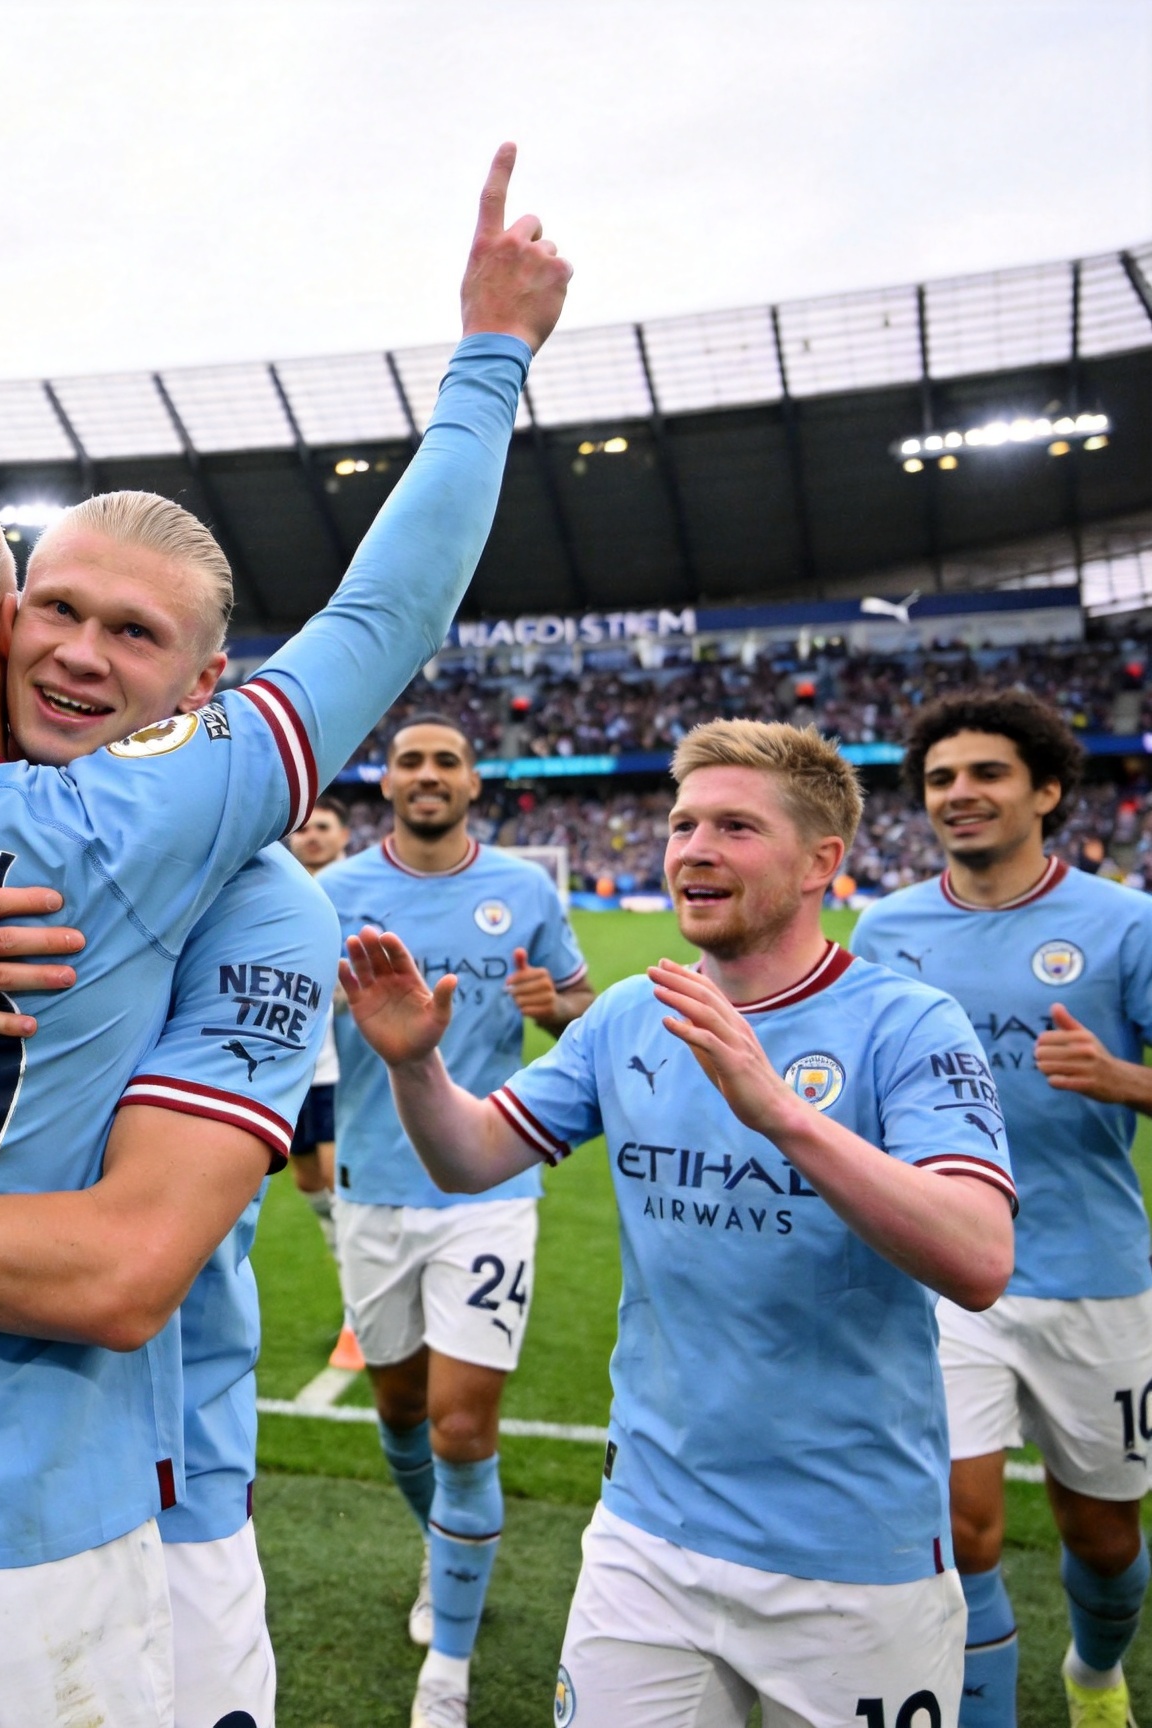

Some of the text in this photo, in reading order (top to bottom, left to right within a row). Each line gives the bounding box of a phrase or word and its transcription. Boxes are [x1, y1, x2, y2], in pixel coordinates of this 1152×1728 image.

[219, 964, 322, 1011] NEXEN
[423, 956, 508, 980] HAD
[232, 996, 307, 1043] TIRE
[930, 1052, 994, 1082] NEX
[948, 1078, 999, 1111] TIR
[644, 1196, 793, 1236] AIRWAYS
[466, 1253, 526, 1317] 24
